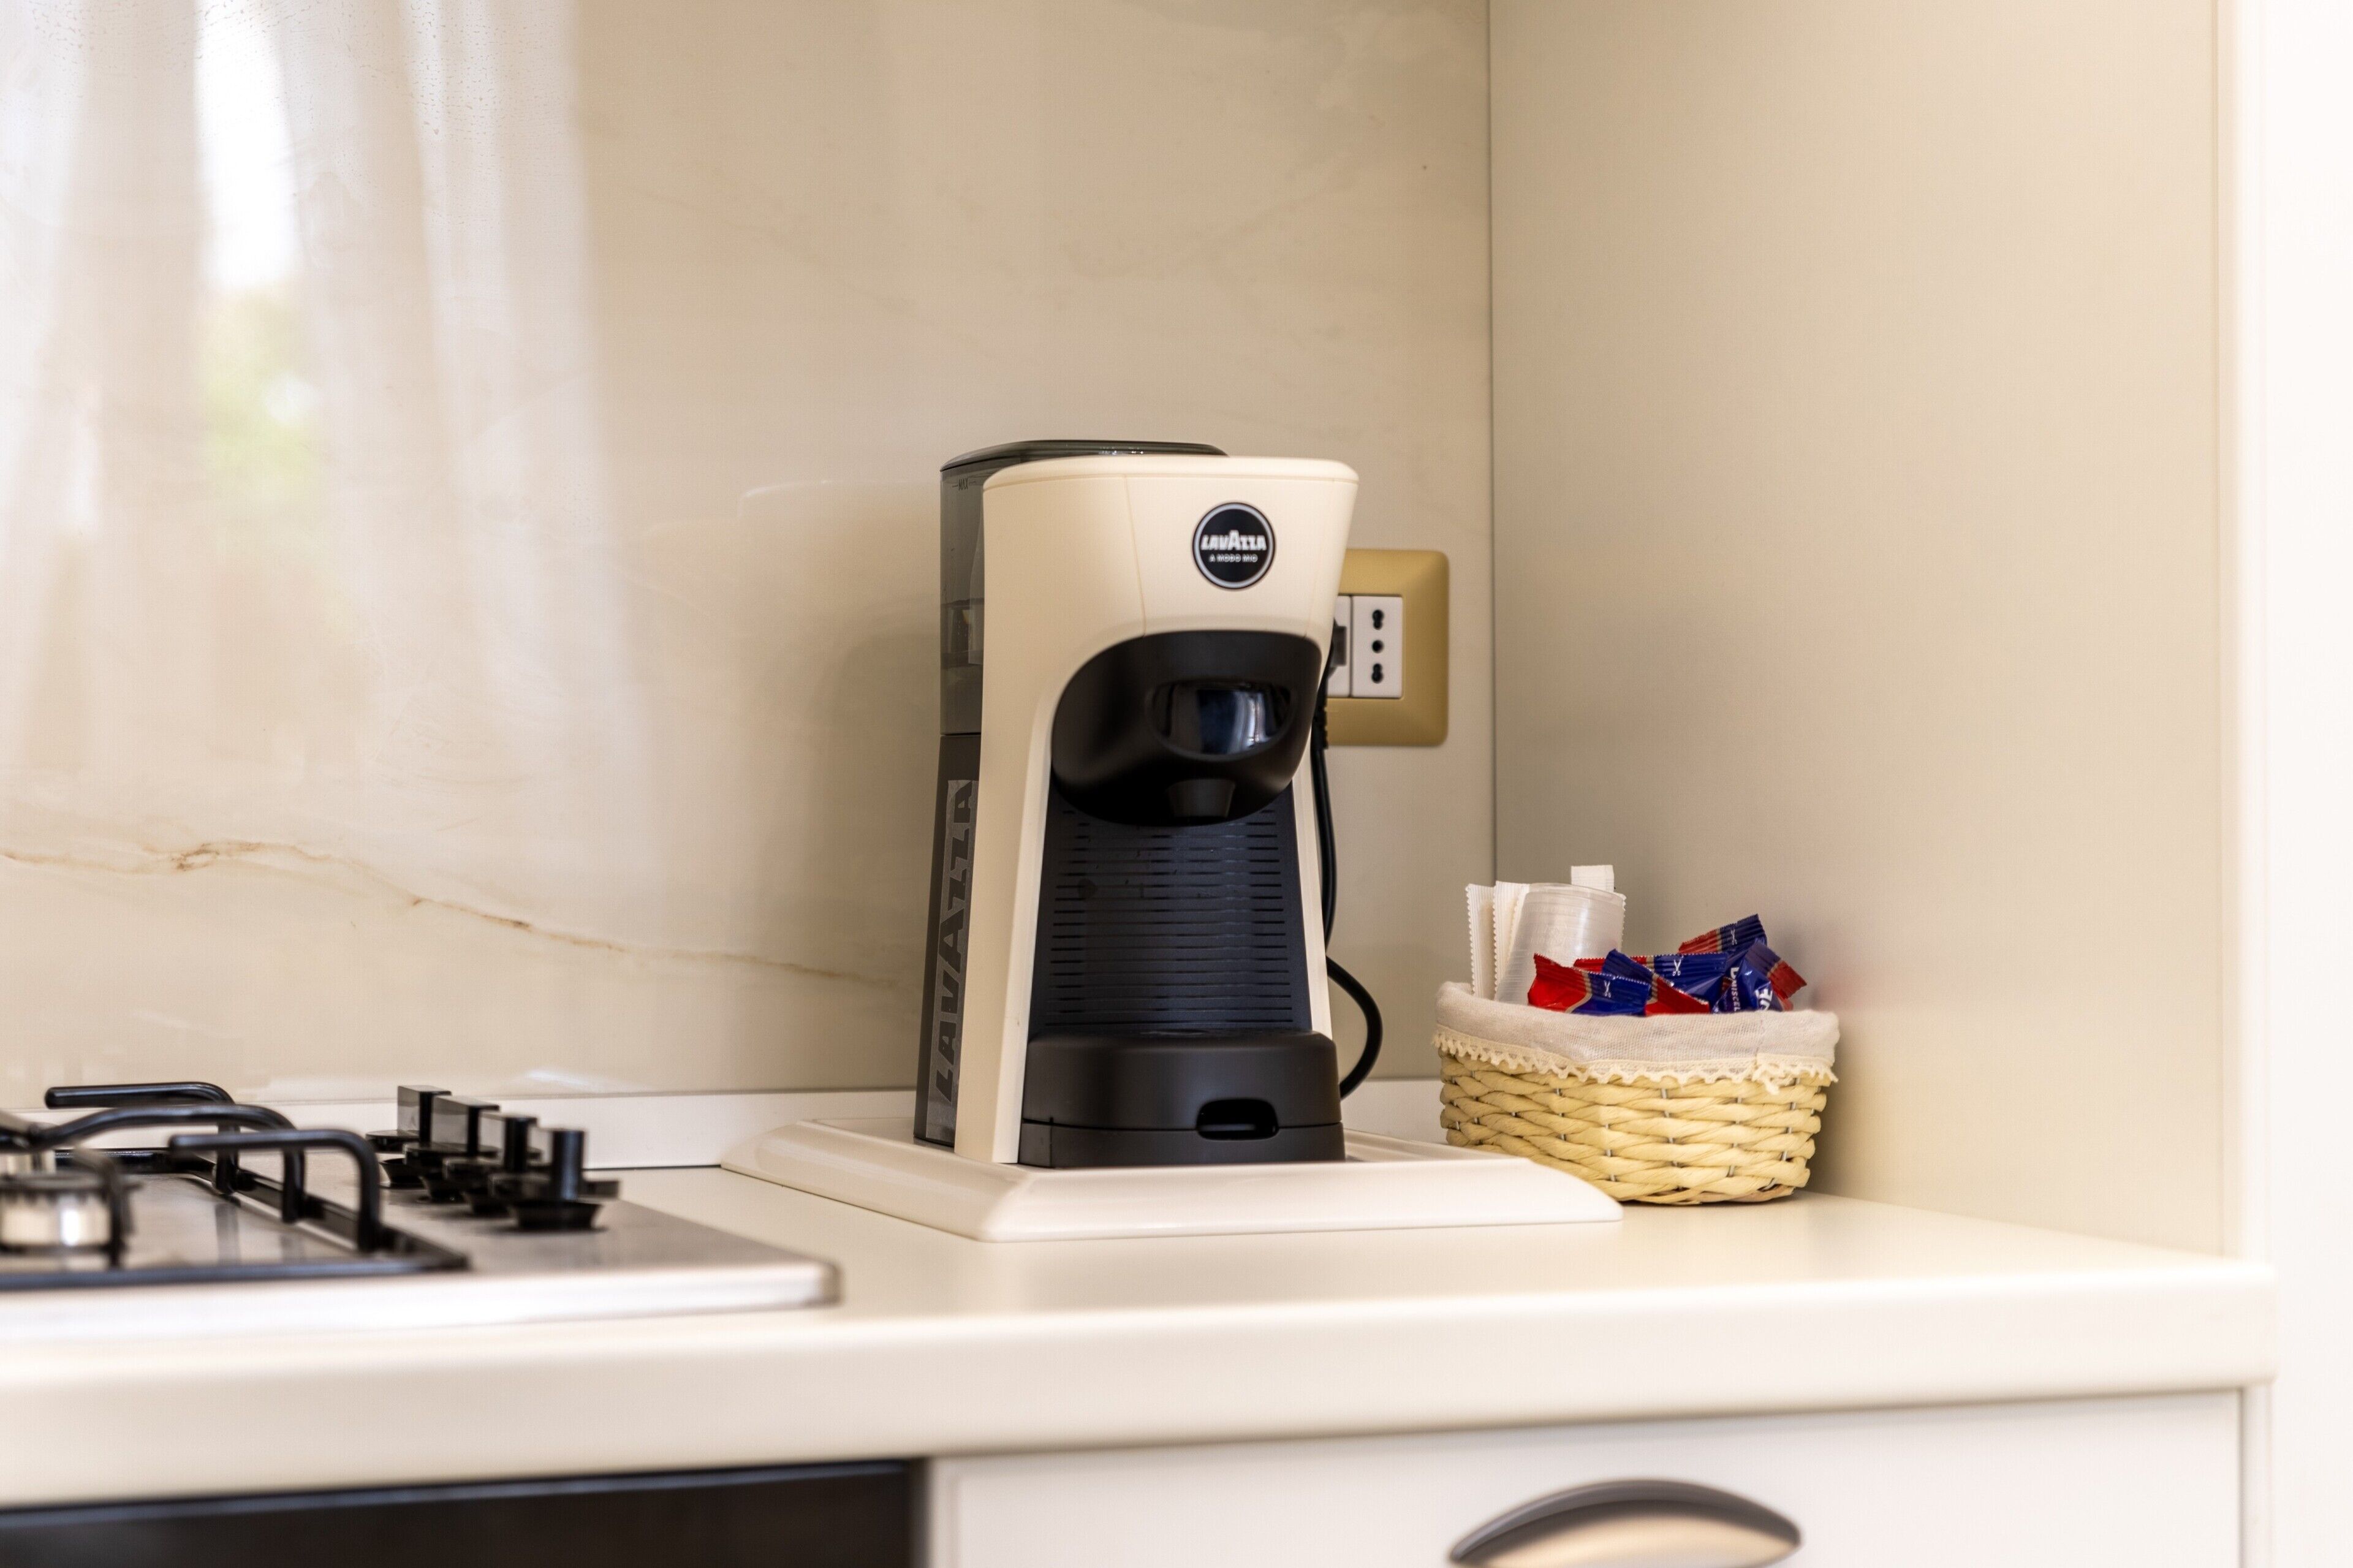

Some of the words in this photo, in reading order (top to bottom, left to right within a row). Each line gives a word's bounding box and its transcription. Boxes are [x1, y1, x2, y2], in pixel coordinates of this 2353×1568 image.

[1200, 529, 1267, 550] LAVAZZA
[1210, 554, 1216, 562] A
[936, 780, 974, 1103] LAVAZZA
